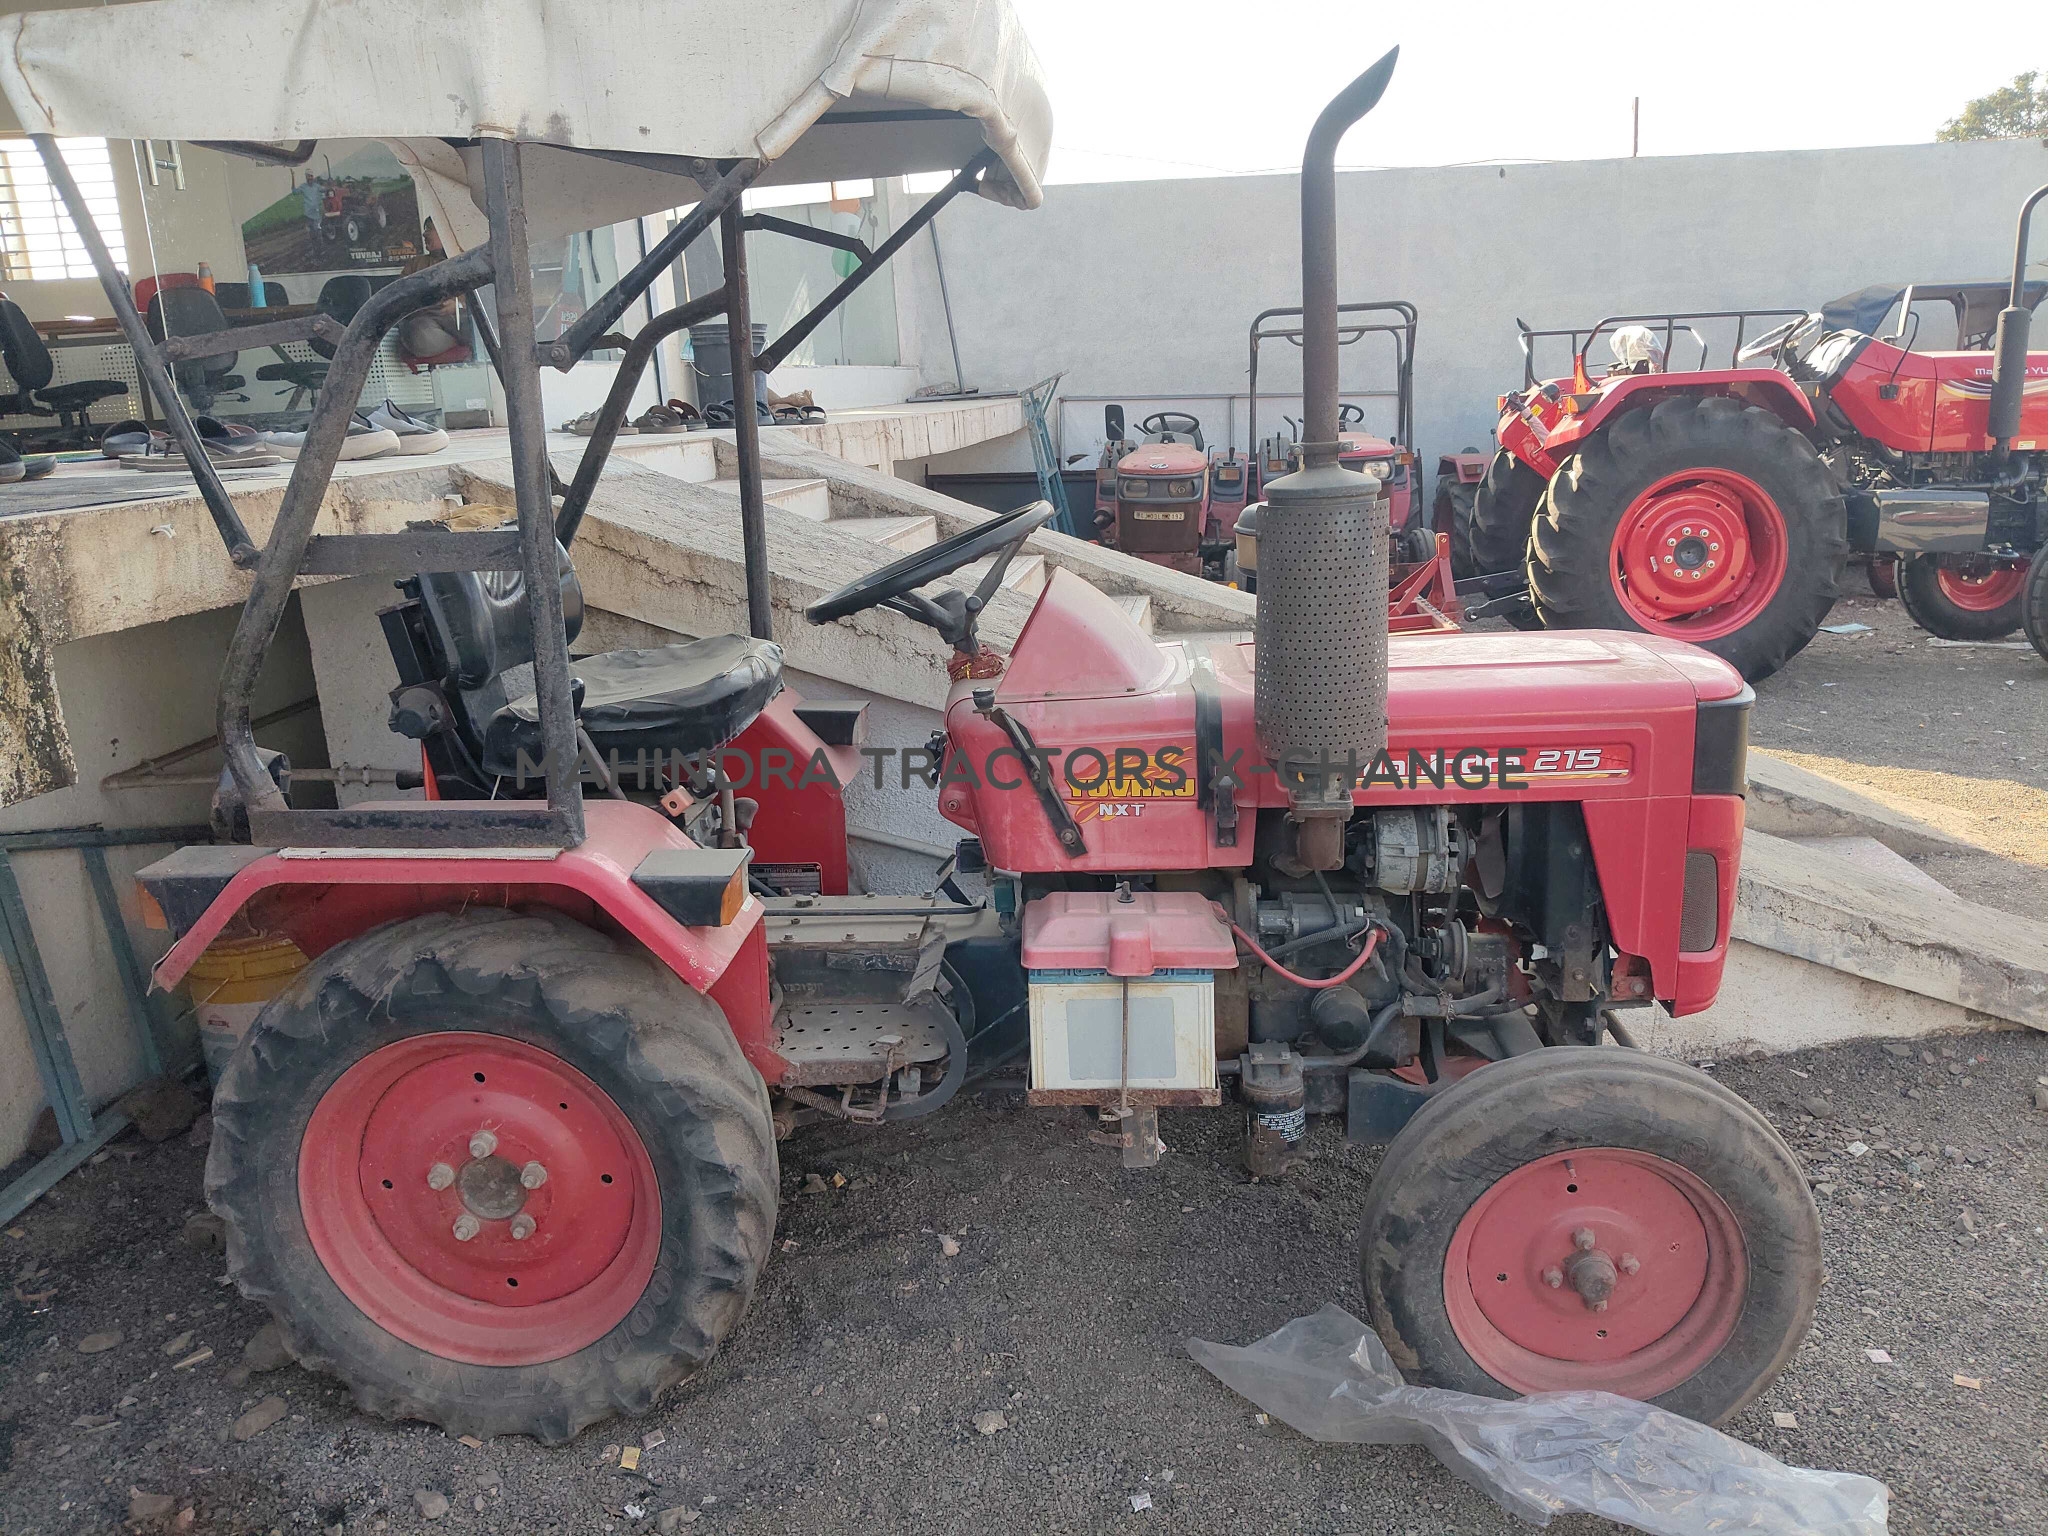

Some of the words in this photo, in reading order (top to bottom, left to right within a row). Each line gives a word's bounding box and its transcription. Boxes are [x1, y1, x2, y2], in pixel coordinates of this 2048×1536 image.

[1533, 749, 1602, 771] 215
[1065, 778, 1196, 797] YUVRAJ
[1099, 803, 1145, 816] NXT
